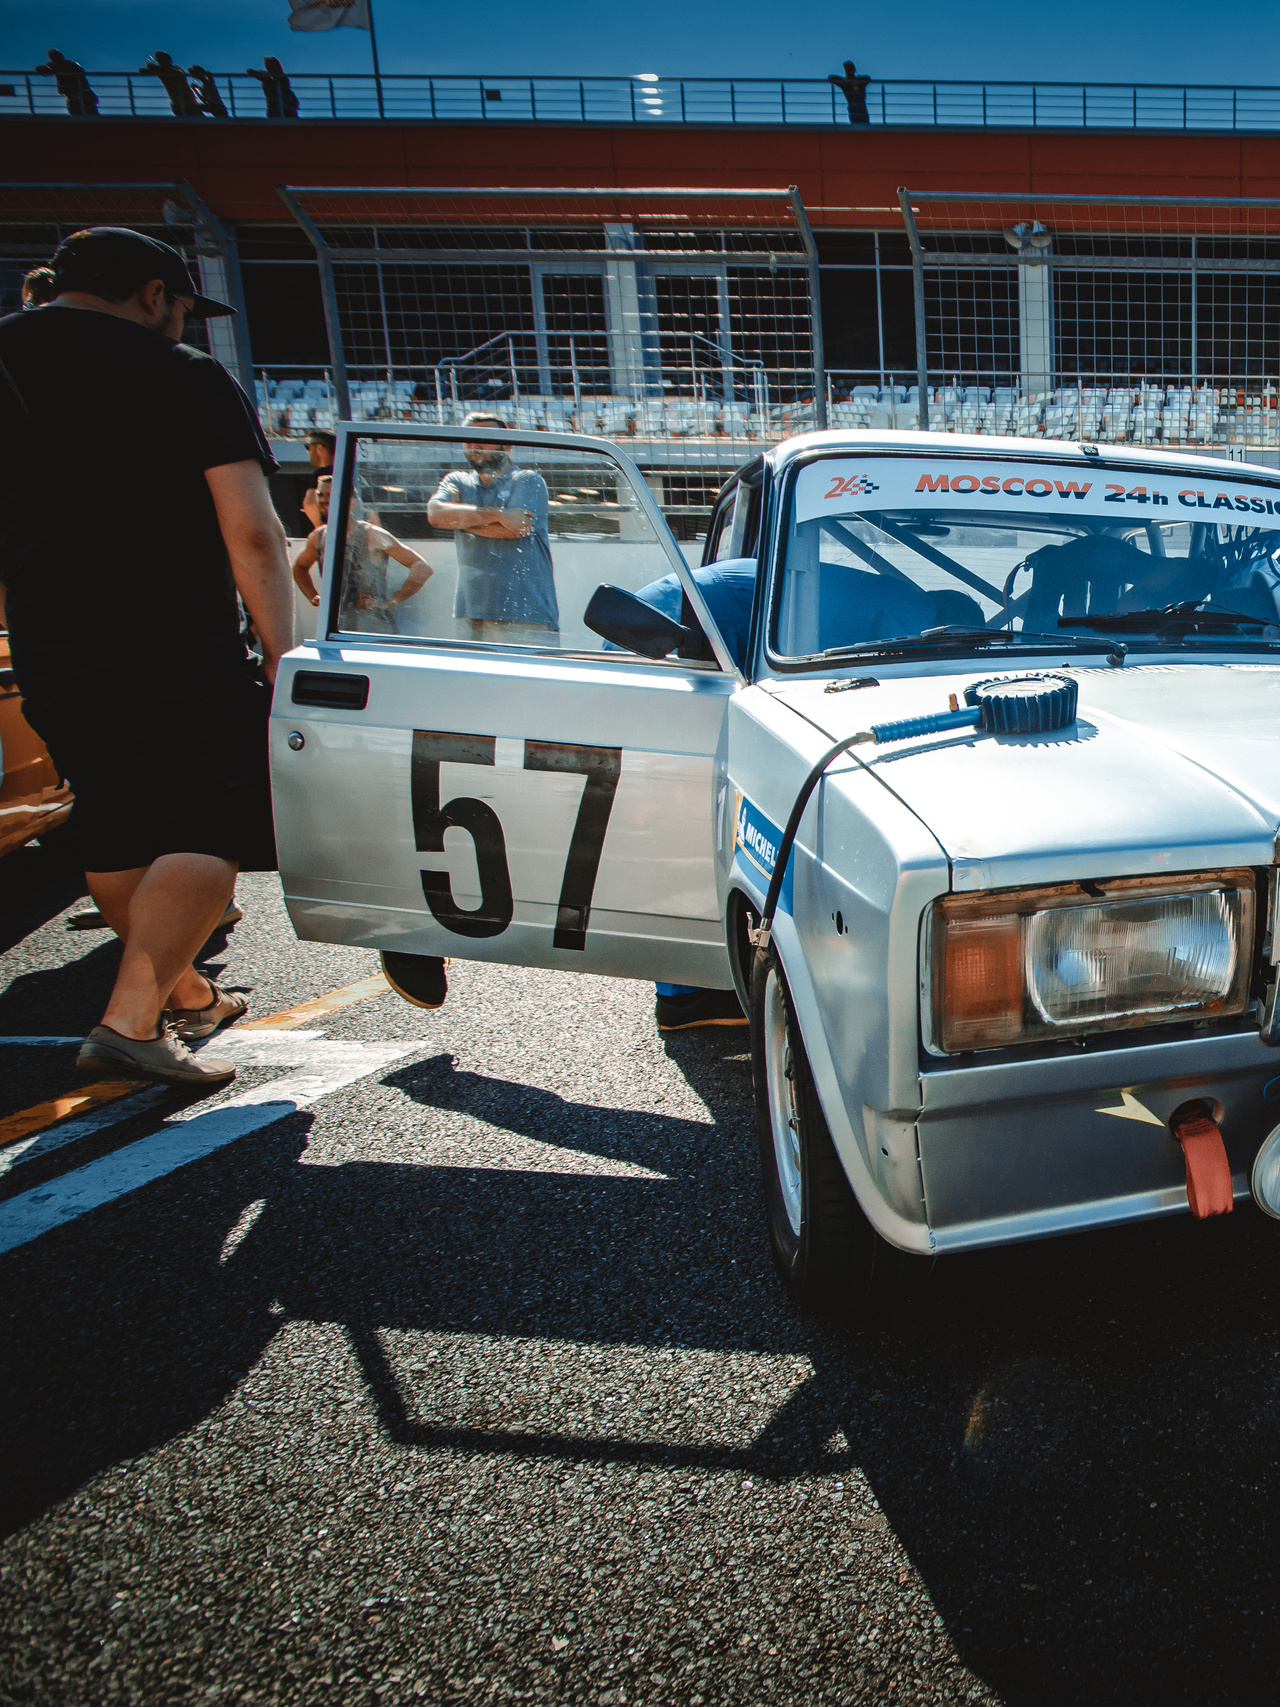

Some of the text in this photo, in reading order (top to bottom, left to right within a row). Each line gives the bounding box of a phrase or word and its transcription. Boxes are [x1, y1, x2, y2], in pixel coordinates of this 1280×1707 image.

[914, 473, 1093, 500] MOSCOW
[1104, 483, 1169, 506] 24h
[410, 728, 623, 952] 57
[745, 822, 783, 872] MICHEL
